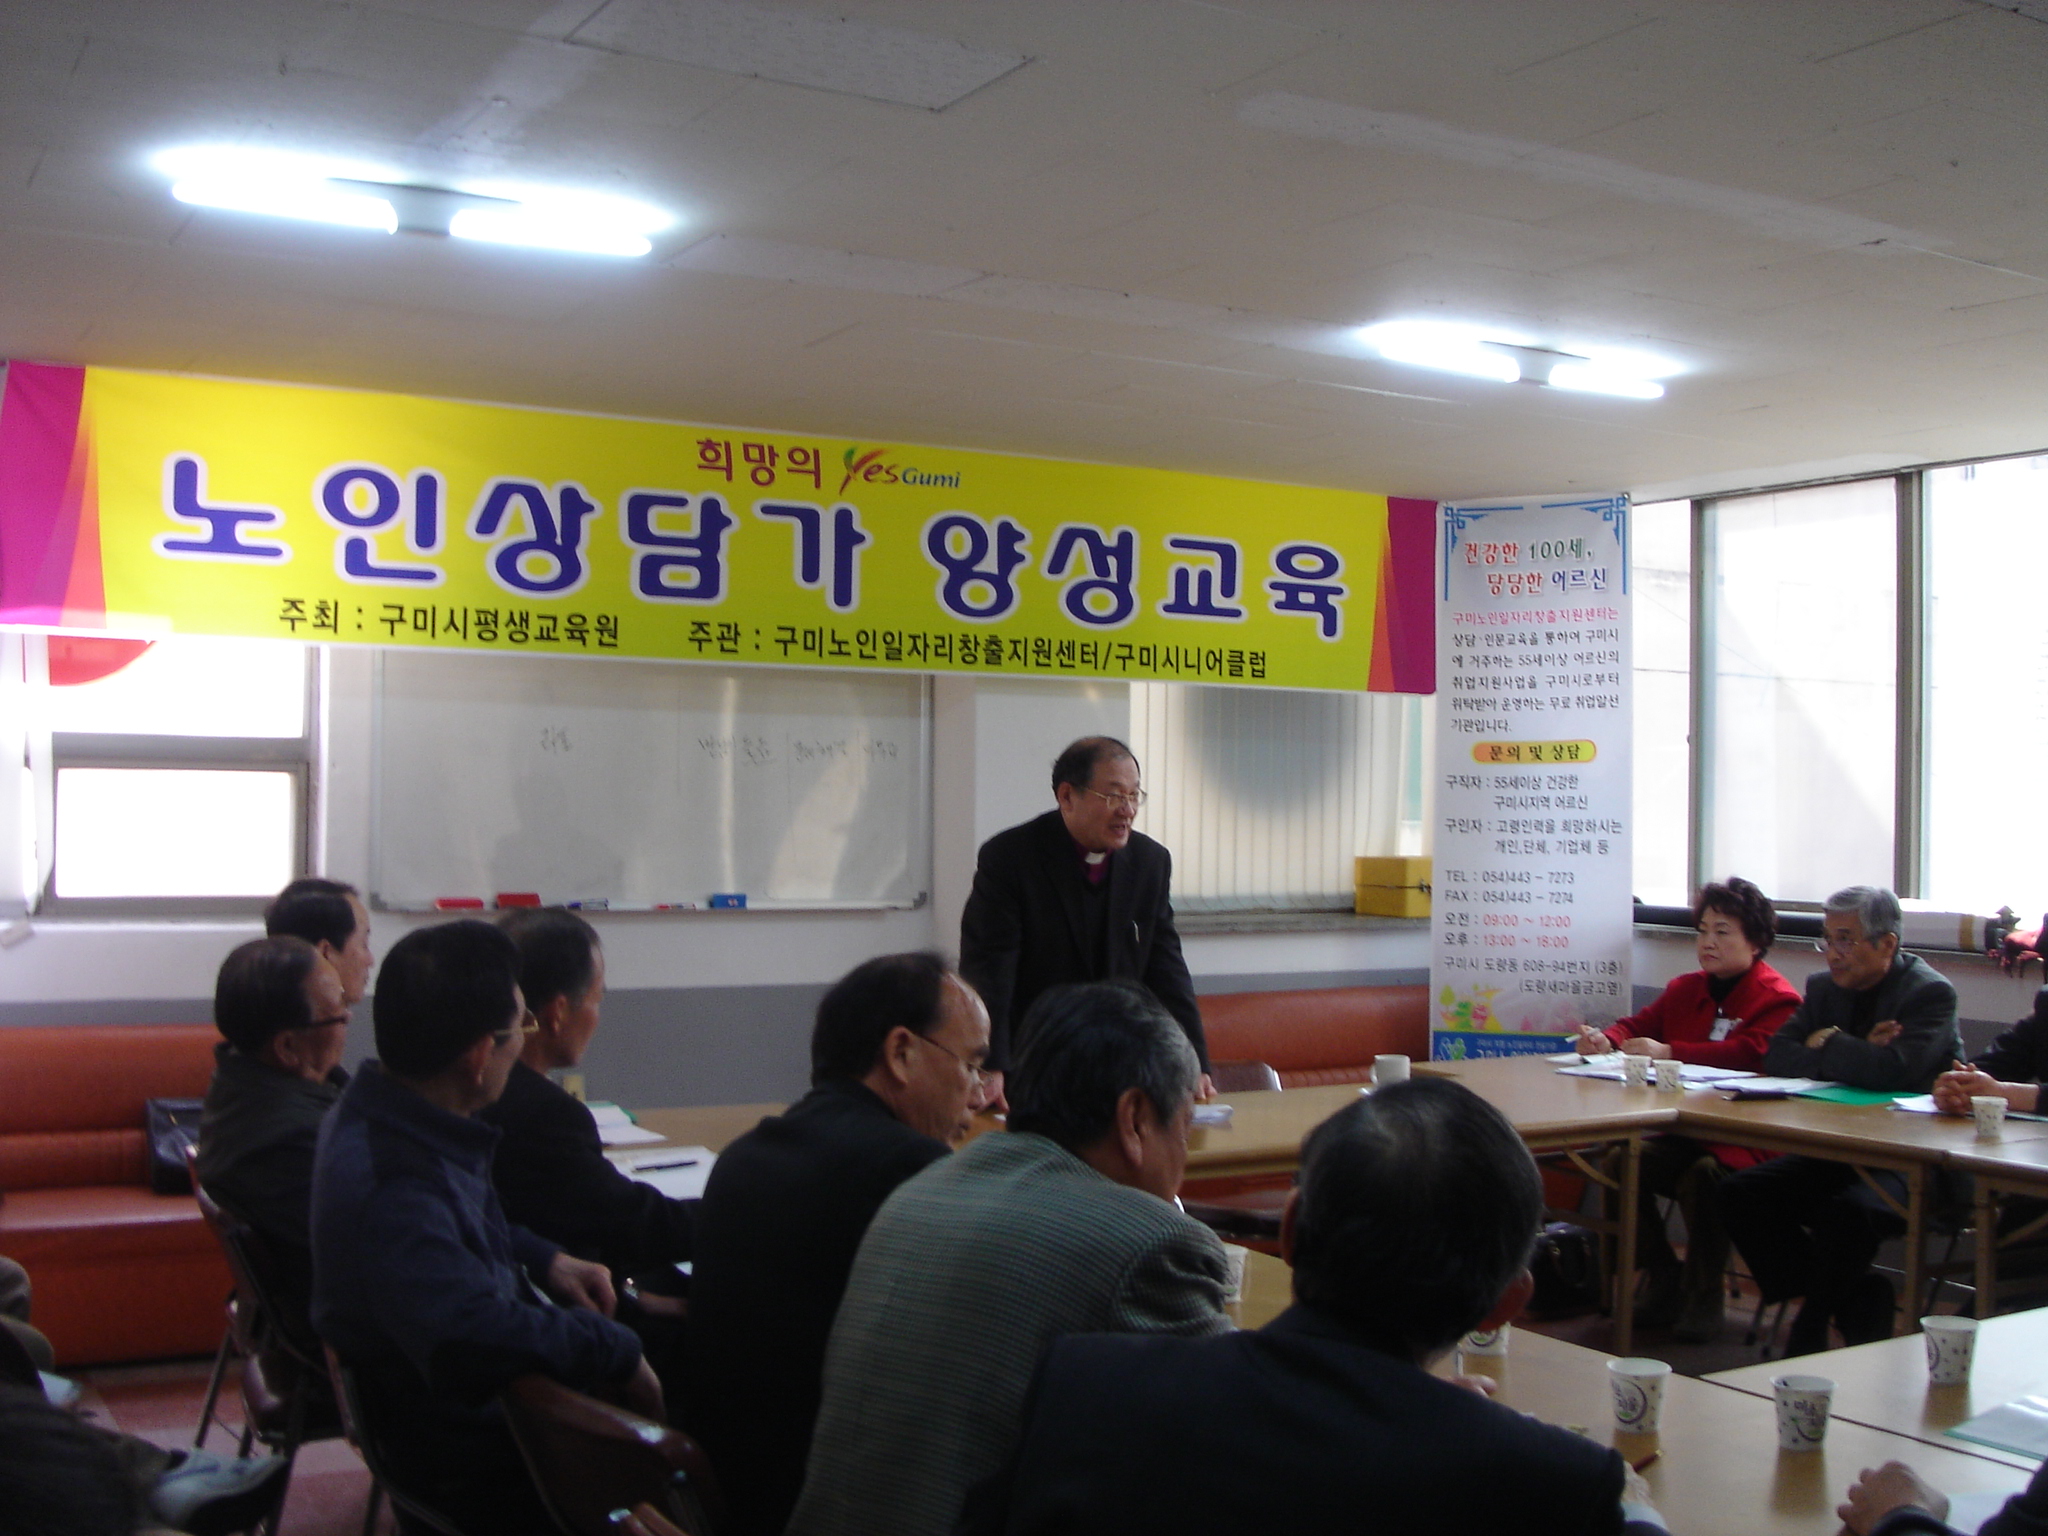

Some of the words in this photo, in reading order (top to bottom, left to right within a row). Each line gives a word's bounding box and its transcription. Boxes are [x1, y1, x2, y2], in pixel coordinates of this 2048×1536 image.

[696, 437, 822, 490] 희망의
[158, 455, 869, 611] 노인상담가
[924, 511, 1347, 640] 양성교육
[1464, 541, 1520, 566] 건강한
[1528, 537, 1594, 561] 100세,
[1487, 572, 1543, 596] 당당한
[1552, 568, 1607, 592] 어르신
[279, 597, 341, 635] 주최
[355, 607, 364, 631] :
[379, 602, 620, 649] 구미시평생교육원
[1452, 607, 1619, 627] 구미노인일자리창출지원센터는
[1544, 630, 1581, 646] 통하여
[1585, 628, 1619, 643] 구미시
[687, 620, 742, 654] 주관
[753, 628, 762, 650] :
[774, 625, 1268, 679] 구미노인일자리창출지원센터/구미시니어클럽
[1452, 654, 1463, 669] 에
[1469, 653, 1514, 669] 거주하는
[1518, 652, 1567, 668] 55세이상
[1573, 650, 1619, 666] 어르신의
[1452, 675, 1538, 690] 취업지원사업을
[1544, 672, 1620, 688] 구미시로부터
[1451, 698, 1498, 713] 위탁받아
[1501, 696, 1545, 712] 운영하는
[1549, 696, 1571, 710] 무료
[1575, 694, 1620, 710] 취업알선
[1450, 718, 1513, 734] 기관입니다.
[1488, 745, 1520, 762] 문의
[1529, 745, 1543, 761] 및
[1552, 744, 1581, 761] 상담
[1445, 774, 1481, 790] 구직자
[1493, 774, 1542, 791] 55세이상
[1546, 773, 1580, 790] 건강한
[1493, 794, 1551, 811] 구미시지역
[1555, 794, 1589, 811] 어르신
[1444, 817, 1483, 834] 구인자
[1497, 817, 1556, 834] 고령인력을
[1561, 817, 1623, 834] 희망하시는
[1556, 838, 1592, 855] 기업체
[1597, 839, 1610, 855] 등
[1445, 869, 1469, 883] TEL
[1482, 869, 1532, 886] 054)443
[1548, 870, 1575, 885] 7273
[1444, 889, 1469, 903] FAX
[1482, 890, 1532, 906] 054)443
[1548, 891, 1574, 905] 7274
[1444, 911, 1470, 927] 오전
[1483, 913, 1519, 928] 09:00
[1539, 914, 1571, 929] 12:00
[1443, 931, 1469, 947] 오후
[1483, 933, 1517, 948] 13:00
[1536, 934, 1569, 949] 18:00
[1443, 955, 1480, 971] 구미시
